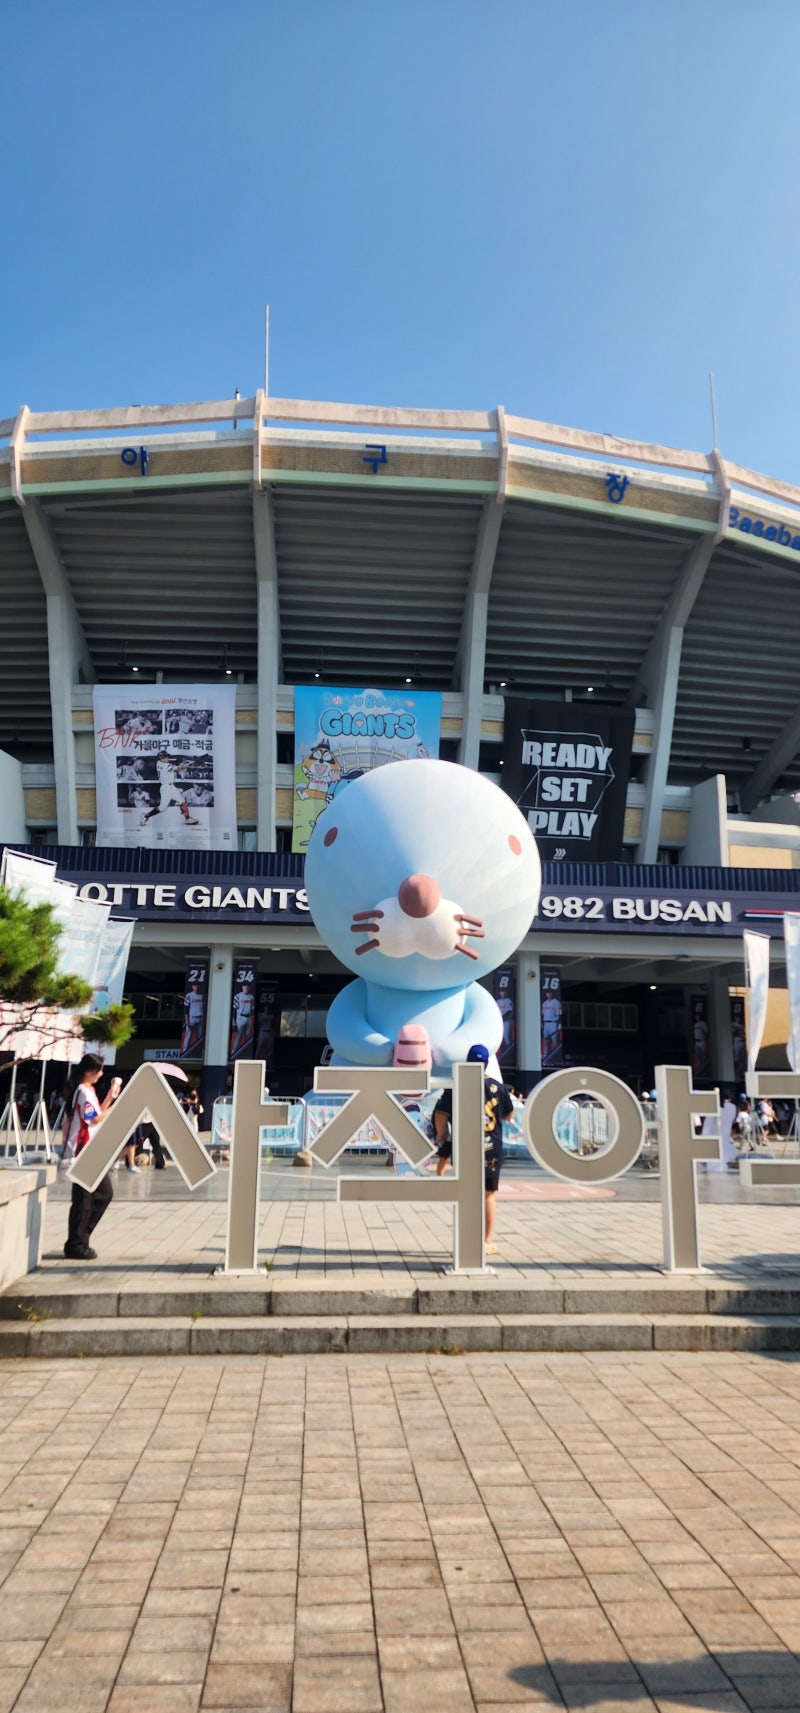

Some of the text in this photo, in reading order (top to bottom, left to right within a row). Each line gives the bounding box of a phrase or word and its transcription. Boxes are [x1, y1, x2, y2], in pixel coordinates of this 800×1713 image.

[121, 444, 630, 503] 야 구 장
[320, 708, 416, 739] GIANTS
[134, 739, 171, 751] 가을야구
[522, 740, 613, 771] READY
[541, 776, 592, 803] SET
[528, 810, 598, 838] PLAY
[79, 882, 311, 911] OTTE GIANTS
[534, 895, 732, 923] 982 BUSAN
[188, 969, 206, 983] 21
[236, 970, 255, 984] 34
[542, 977, 560, 990] 16
[259, 993, 275, 1003] 55
